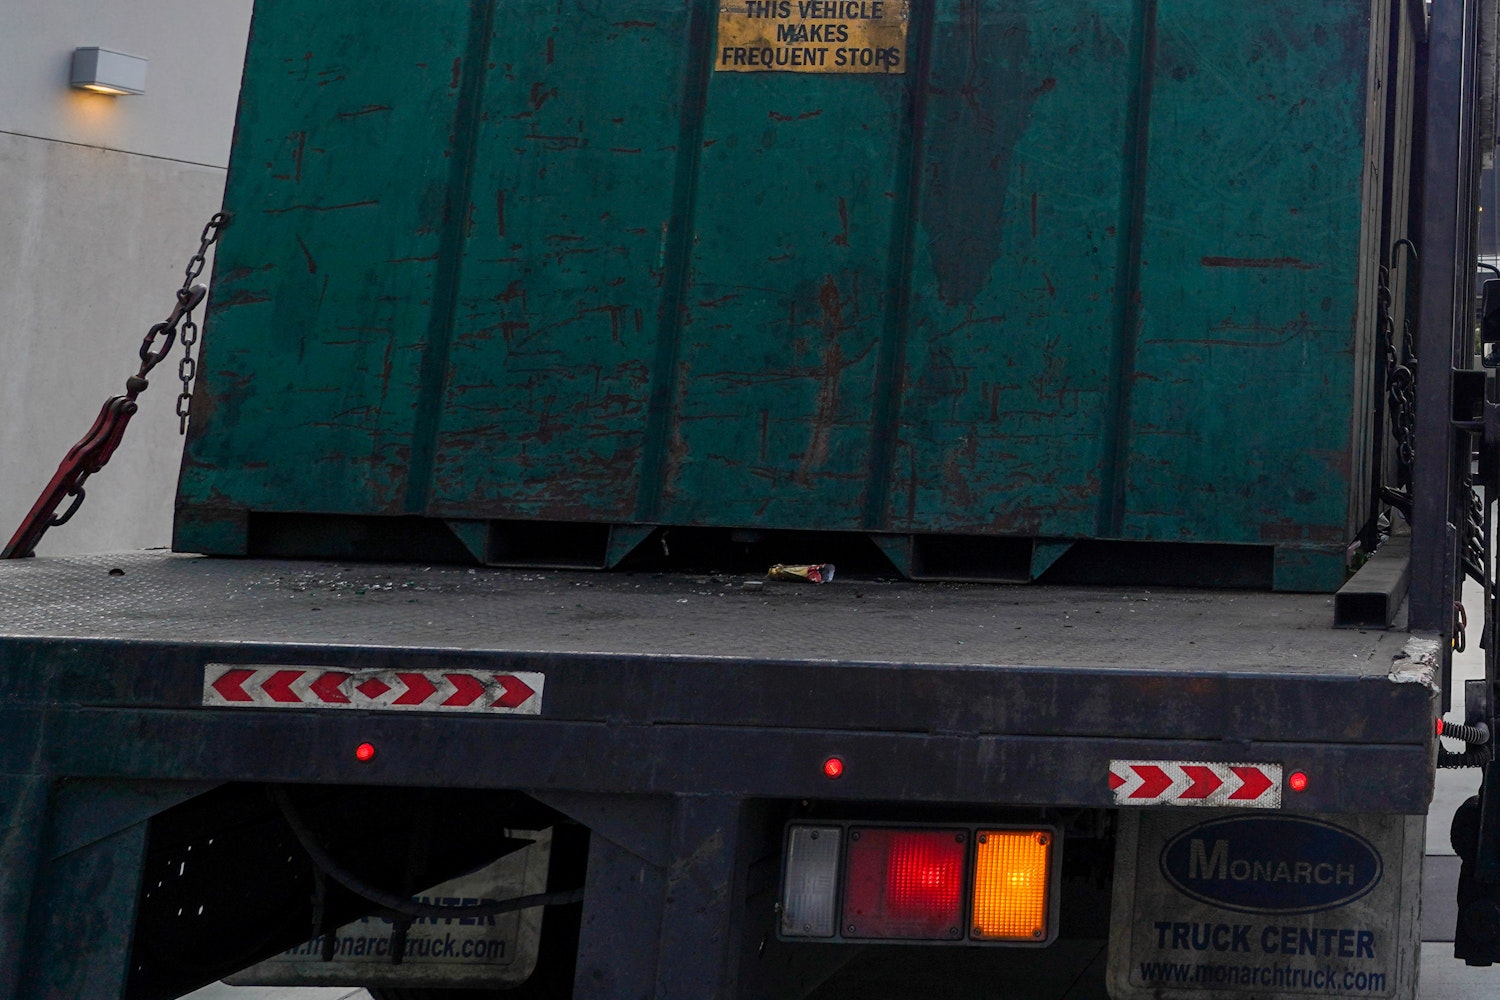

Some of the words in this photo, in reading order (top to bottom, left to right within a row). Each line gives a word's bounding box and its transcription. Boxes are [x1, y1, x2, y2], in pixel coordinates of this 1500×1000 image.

[745, 0, 791, 19] THIS
[798, 0, 883, 19] VEHICLE
[777, 24, 848, 43] MAKES
[721, 47, 828, 69] FREQUENT
[834, 47, 900, 67] STOPS
[1154, 921, 1251, 952] TRUCK
[1261, 926, 1375, 959] CENTER
[1140, 961, 1387, 992] www.monarchtruck.com
